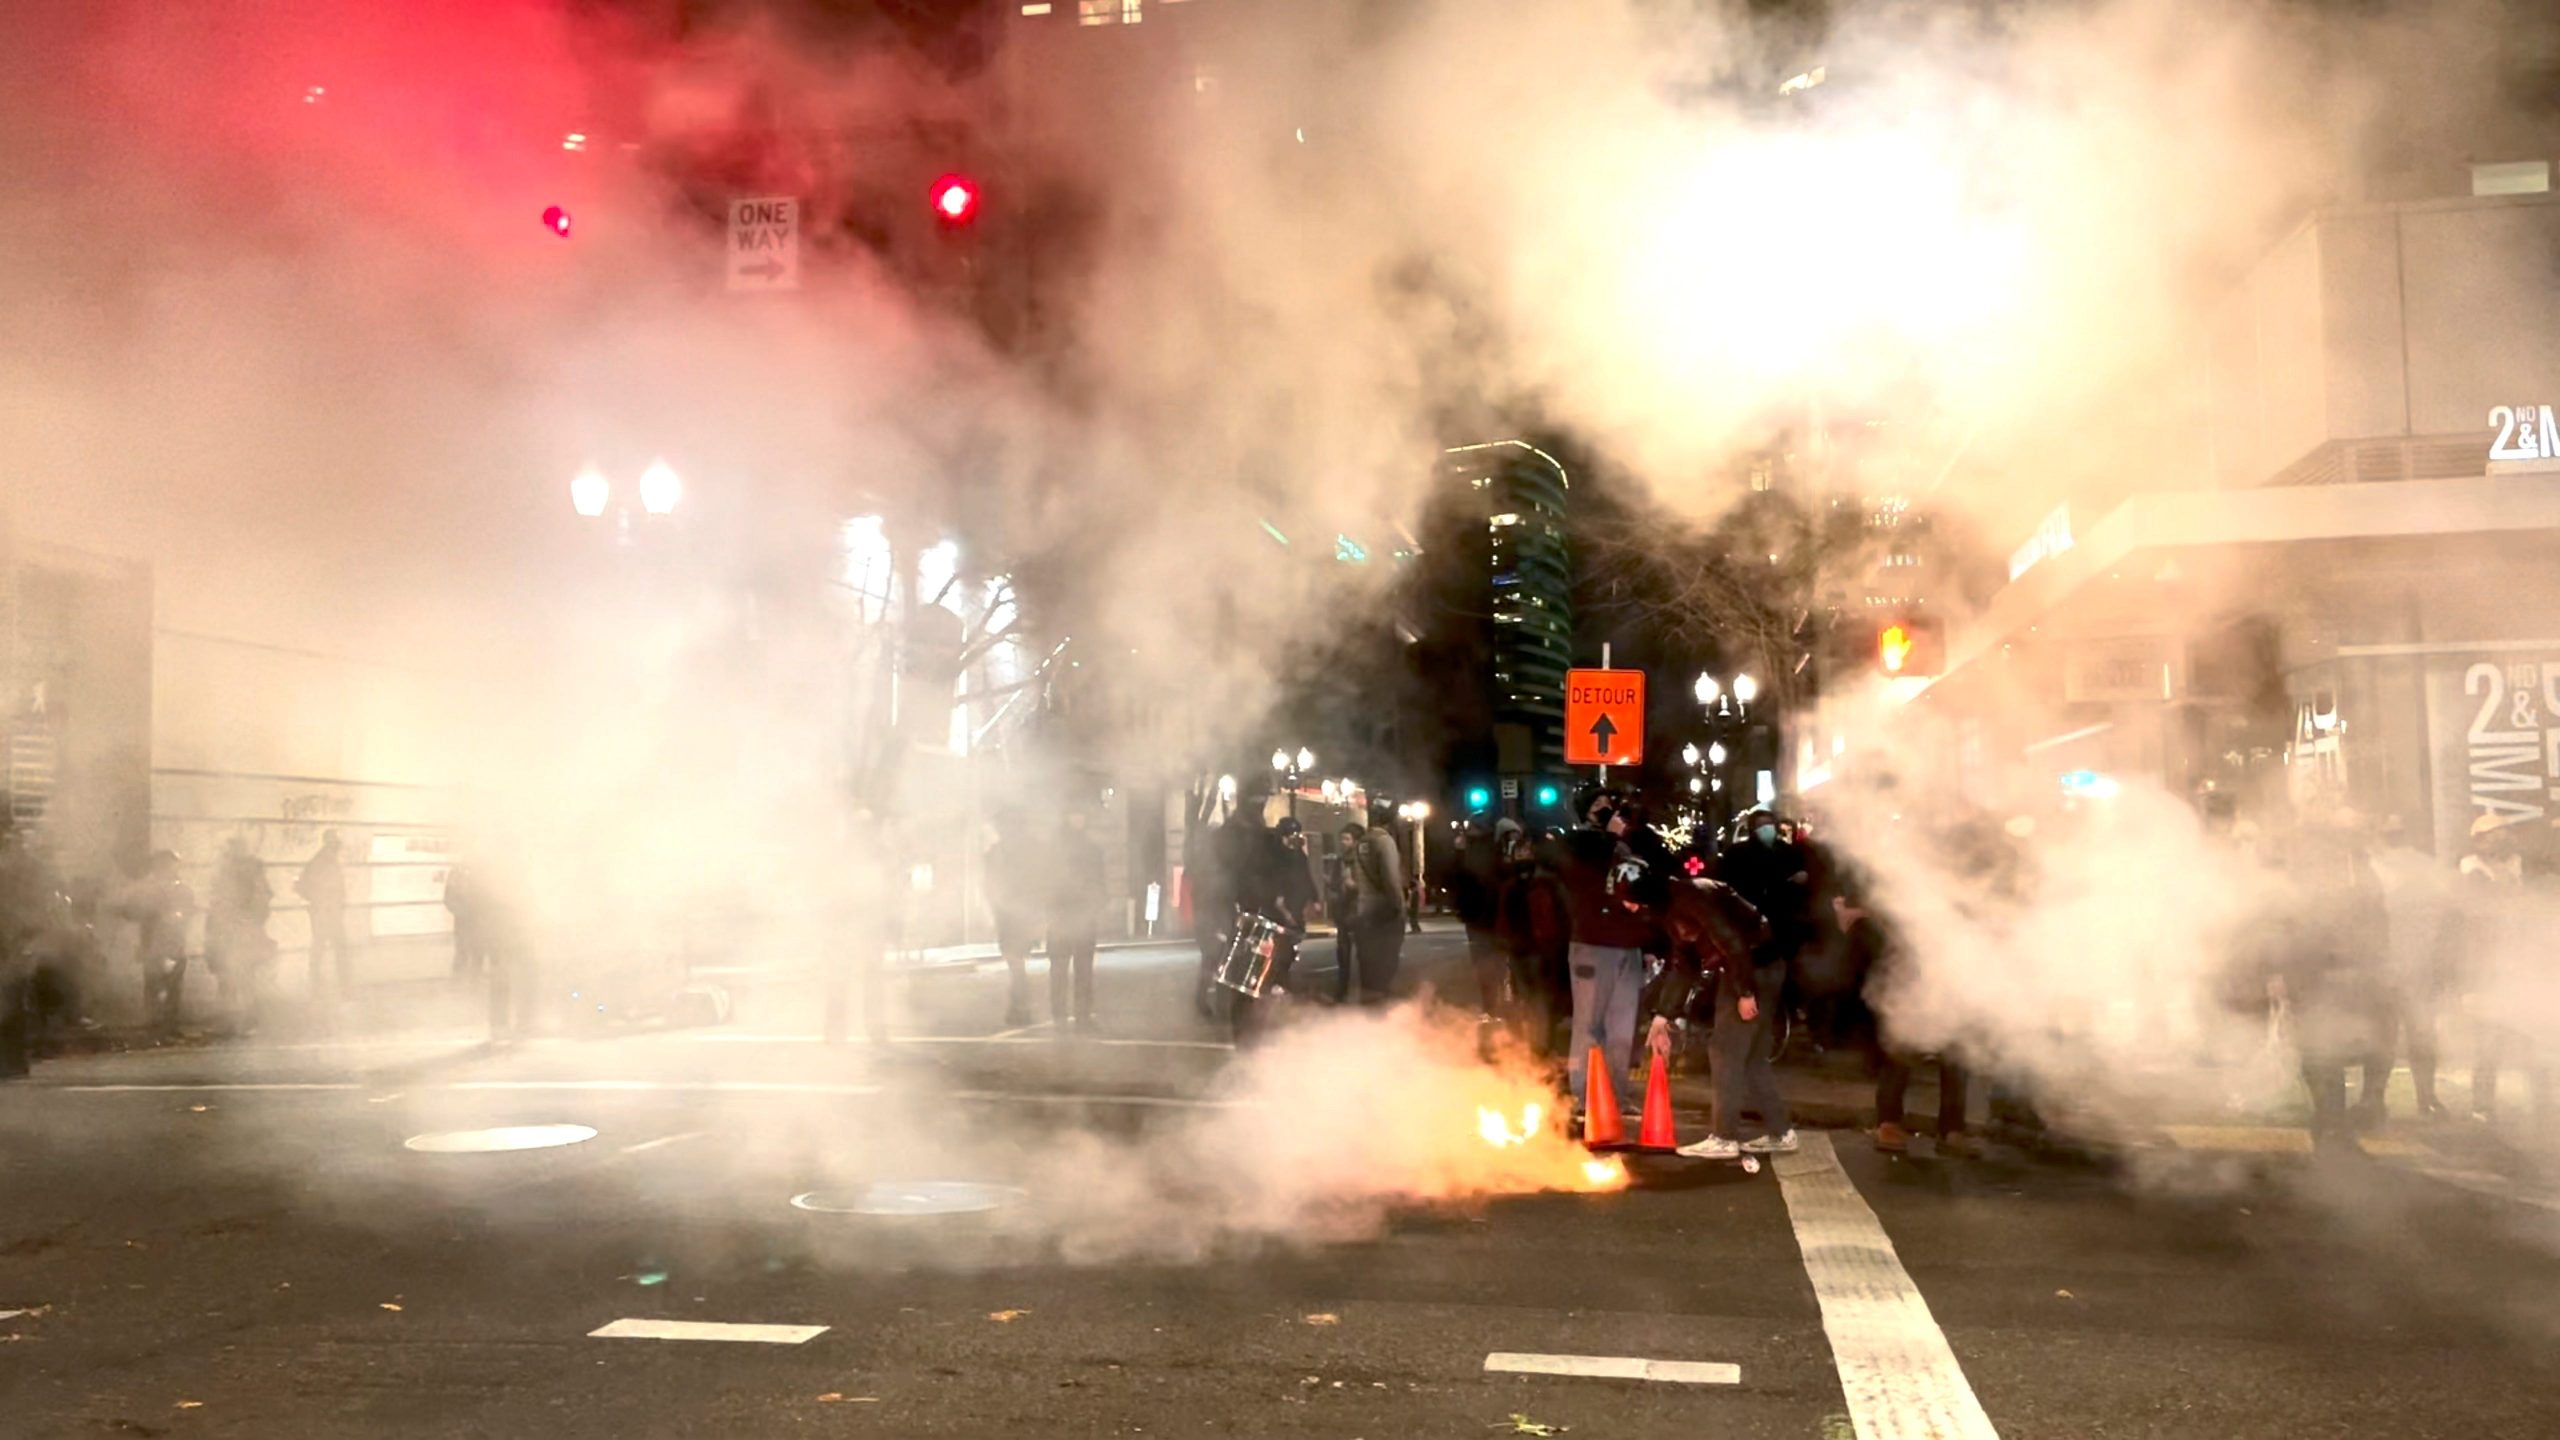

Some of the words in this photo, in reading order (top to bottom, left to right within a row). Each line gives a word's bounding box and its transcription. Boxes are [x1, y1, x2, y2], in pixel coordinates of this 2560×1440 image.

[740, 203, 788, 225] ONE
[738, 228, 789, 251] WAY
[1572, 687, 1636, 705] DETOUR
